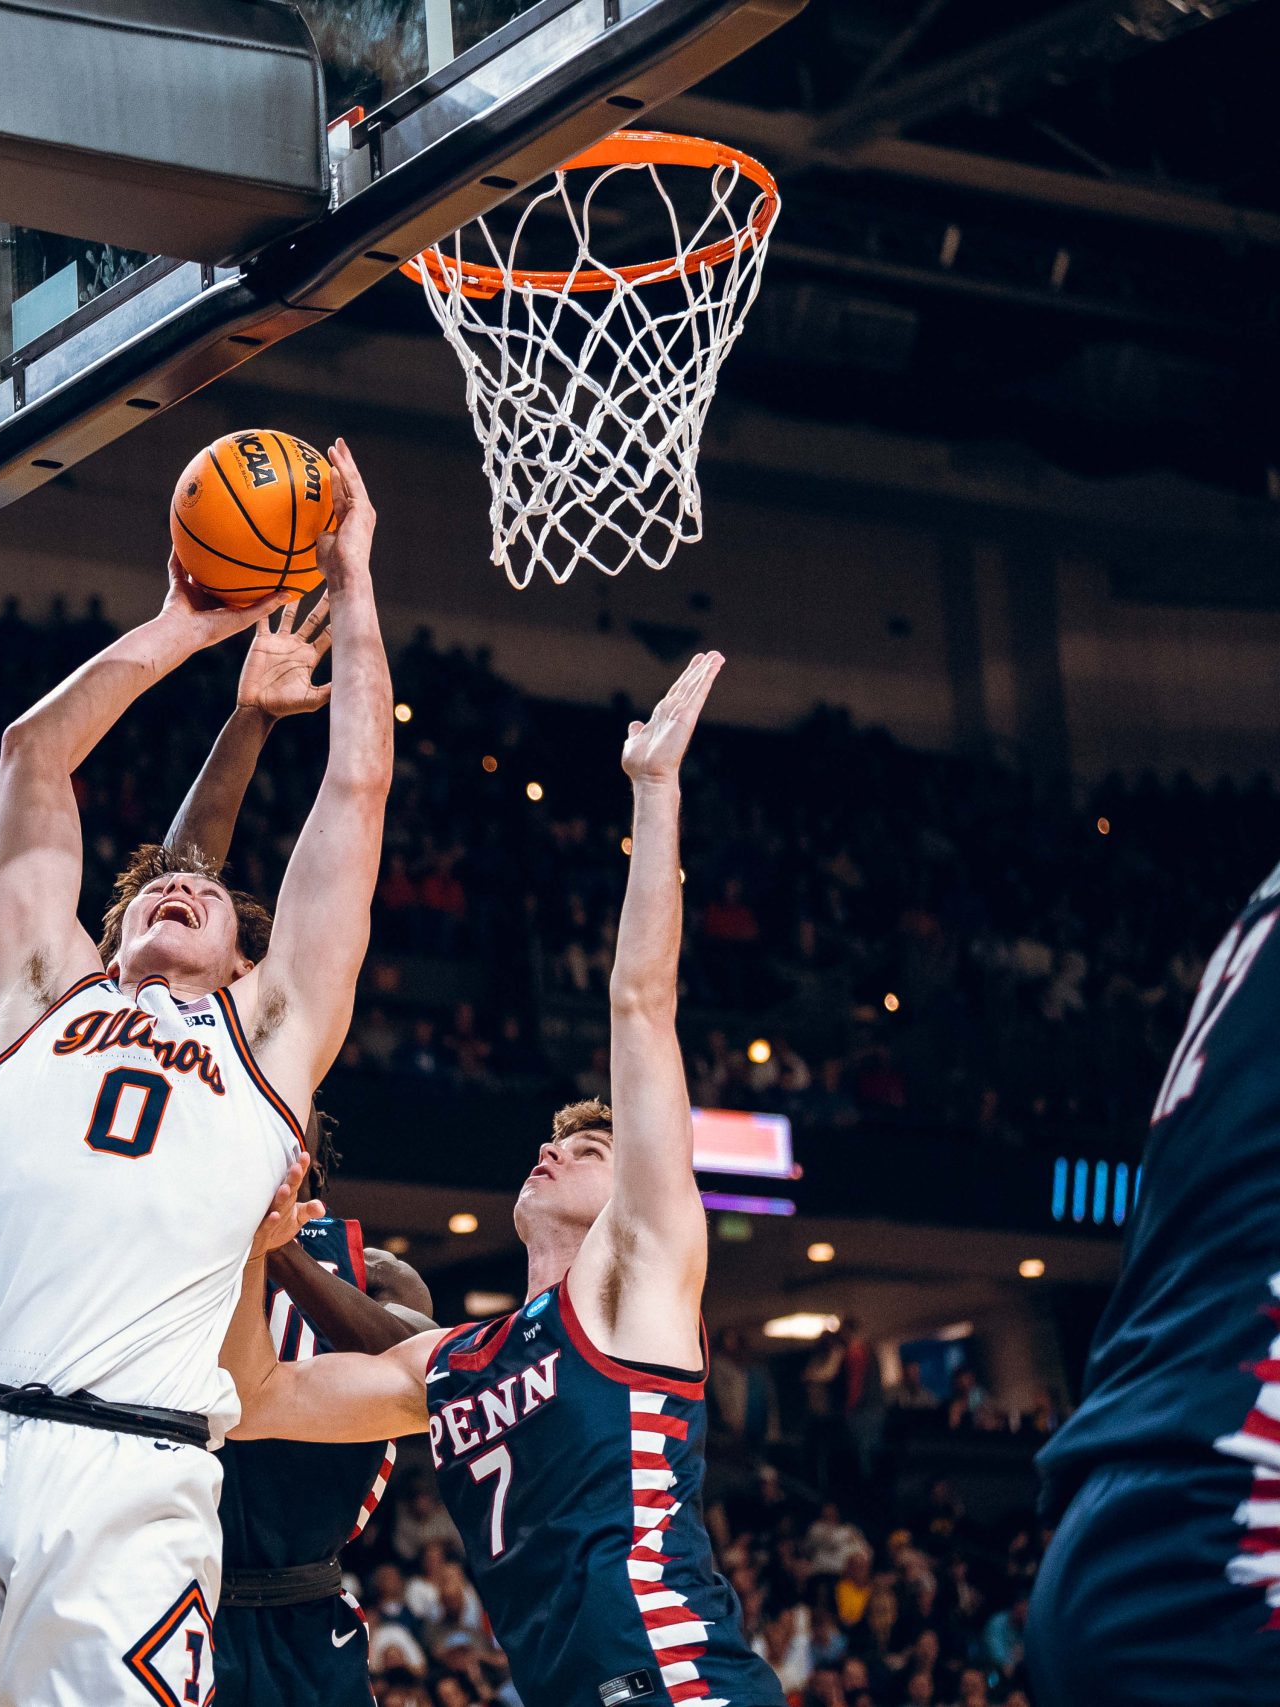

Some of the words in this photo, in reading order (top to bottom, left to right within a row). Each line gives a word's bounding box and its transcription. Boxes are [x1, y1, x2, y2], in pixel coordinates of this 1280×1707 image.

[232, 432, 279, 489] NCAA
[84, 1065, 173, 1160] 0
[300, 1228, 318, 1238] Ivy
[428, 1348, 561, 1474] PENN
[468, 1440, 513, 1559] 7
[635, 1678, 645, 1689] L
